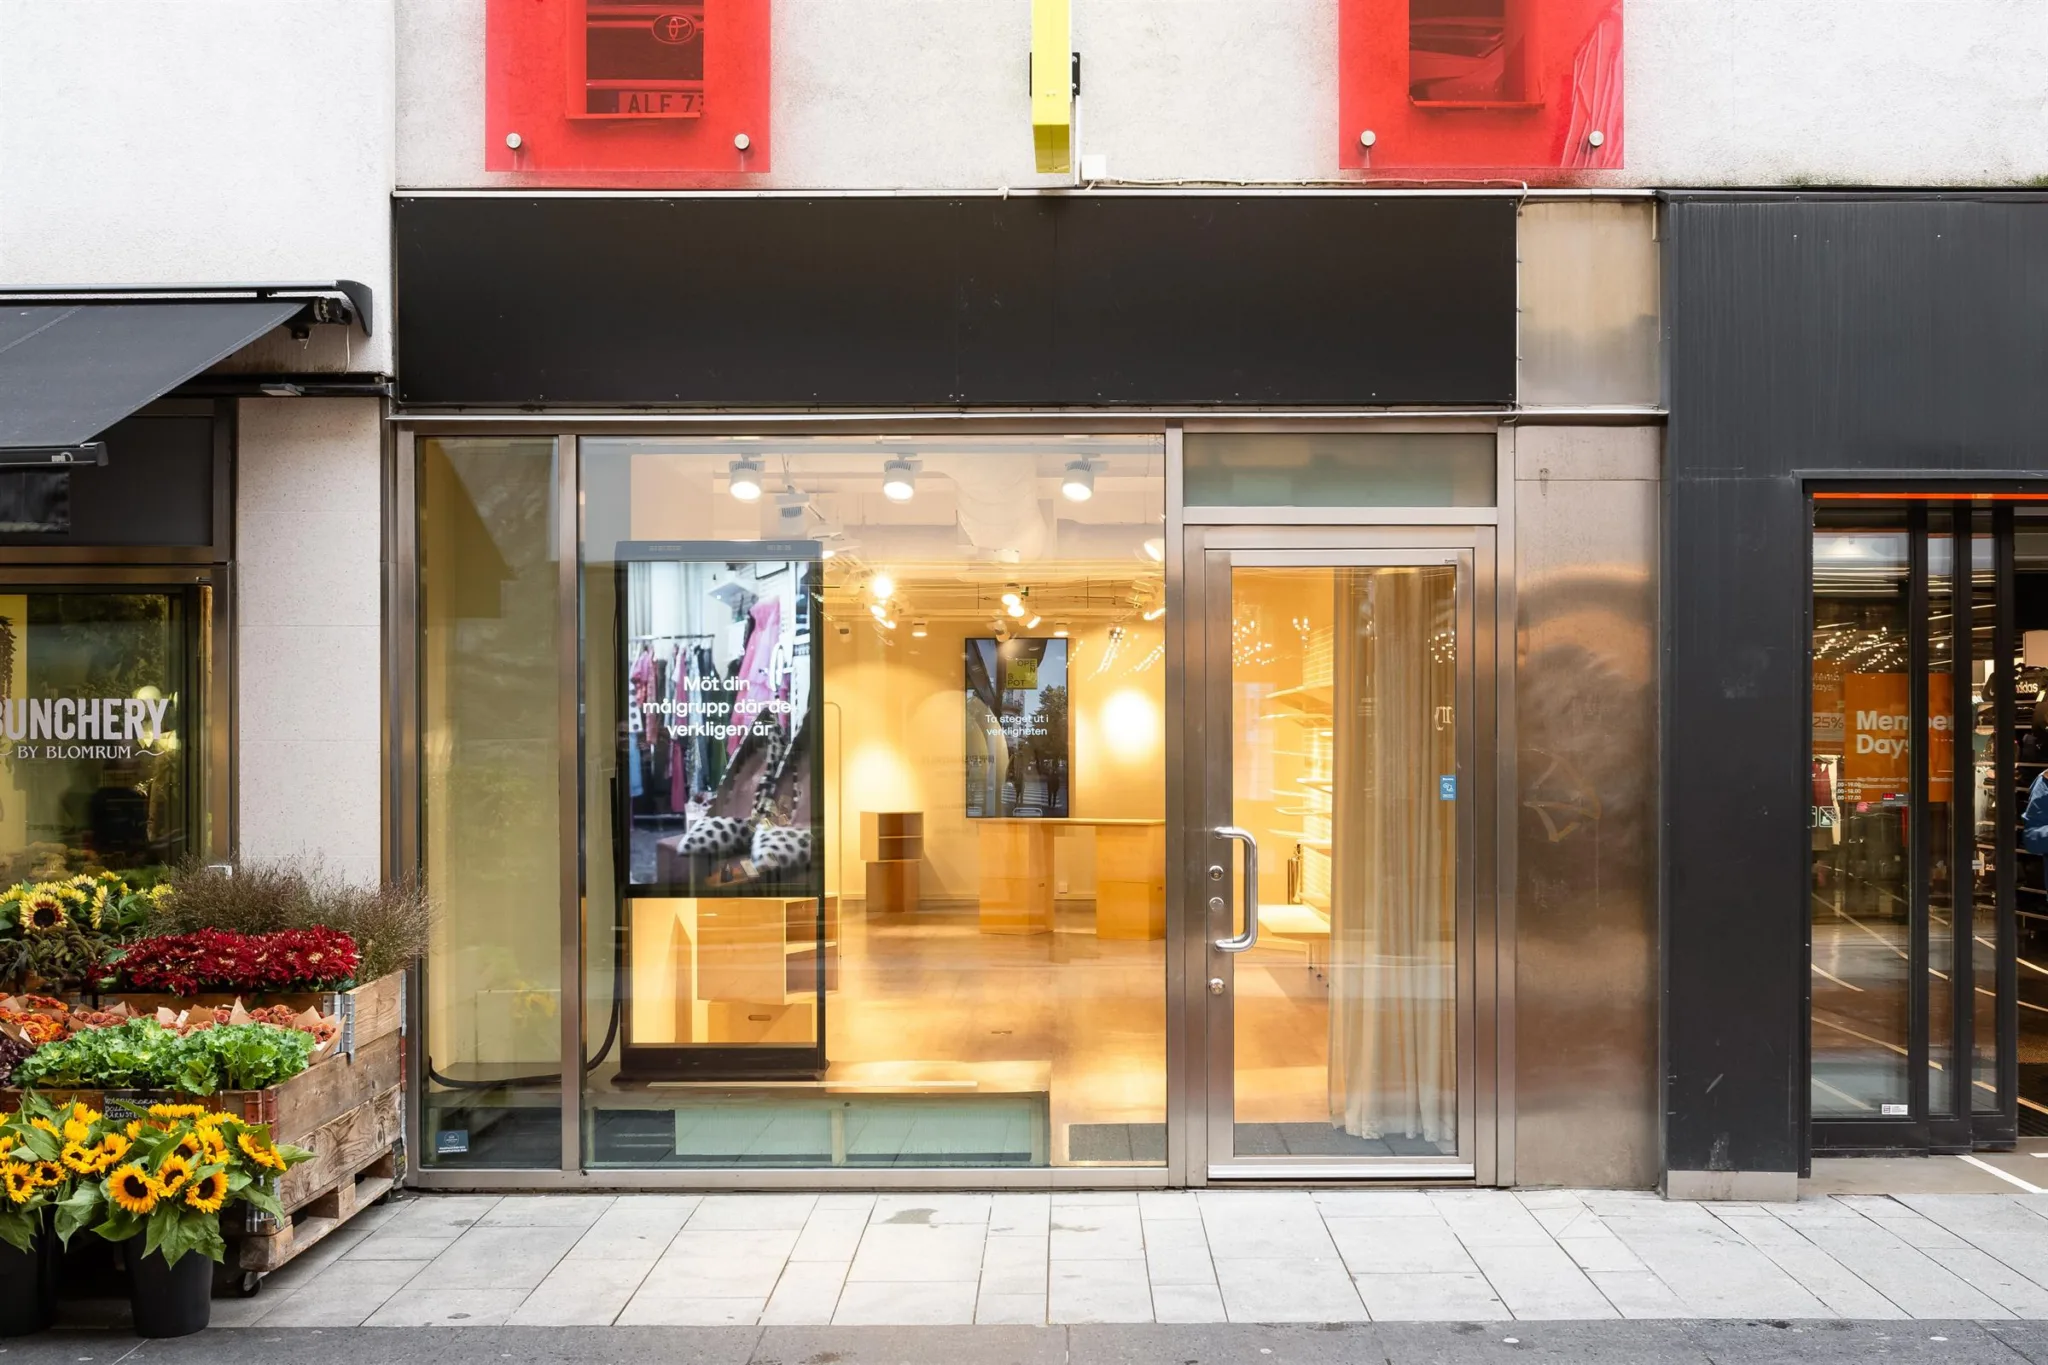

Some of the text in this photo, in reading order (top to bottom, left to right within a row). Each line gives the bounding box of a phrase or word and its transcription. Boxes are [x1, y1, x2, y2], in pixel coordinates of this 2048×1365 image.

[628, 93, 673, 113] ALF
[683, 676, 750, 692] Möt din
[643, 698, 730, 718] målgrupp
[734, 699, 763, 714] där
[0, 698, 170, 742] UNCHERY
[667, 721, 773, 740] verkligen är
[986, 726, 1048, 738] verkligheten
[17, 746, 132, 760] BY BLOMRUM
